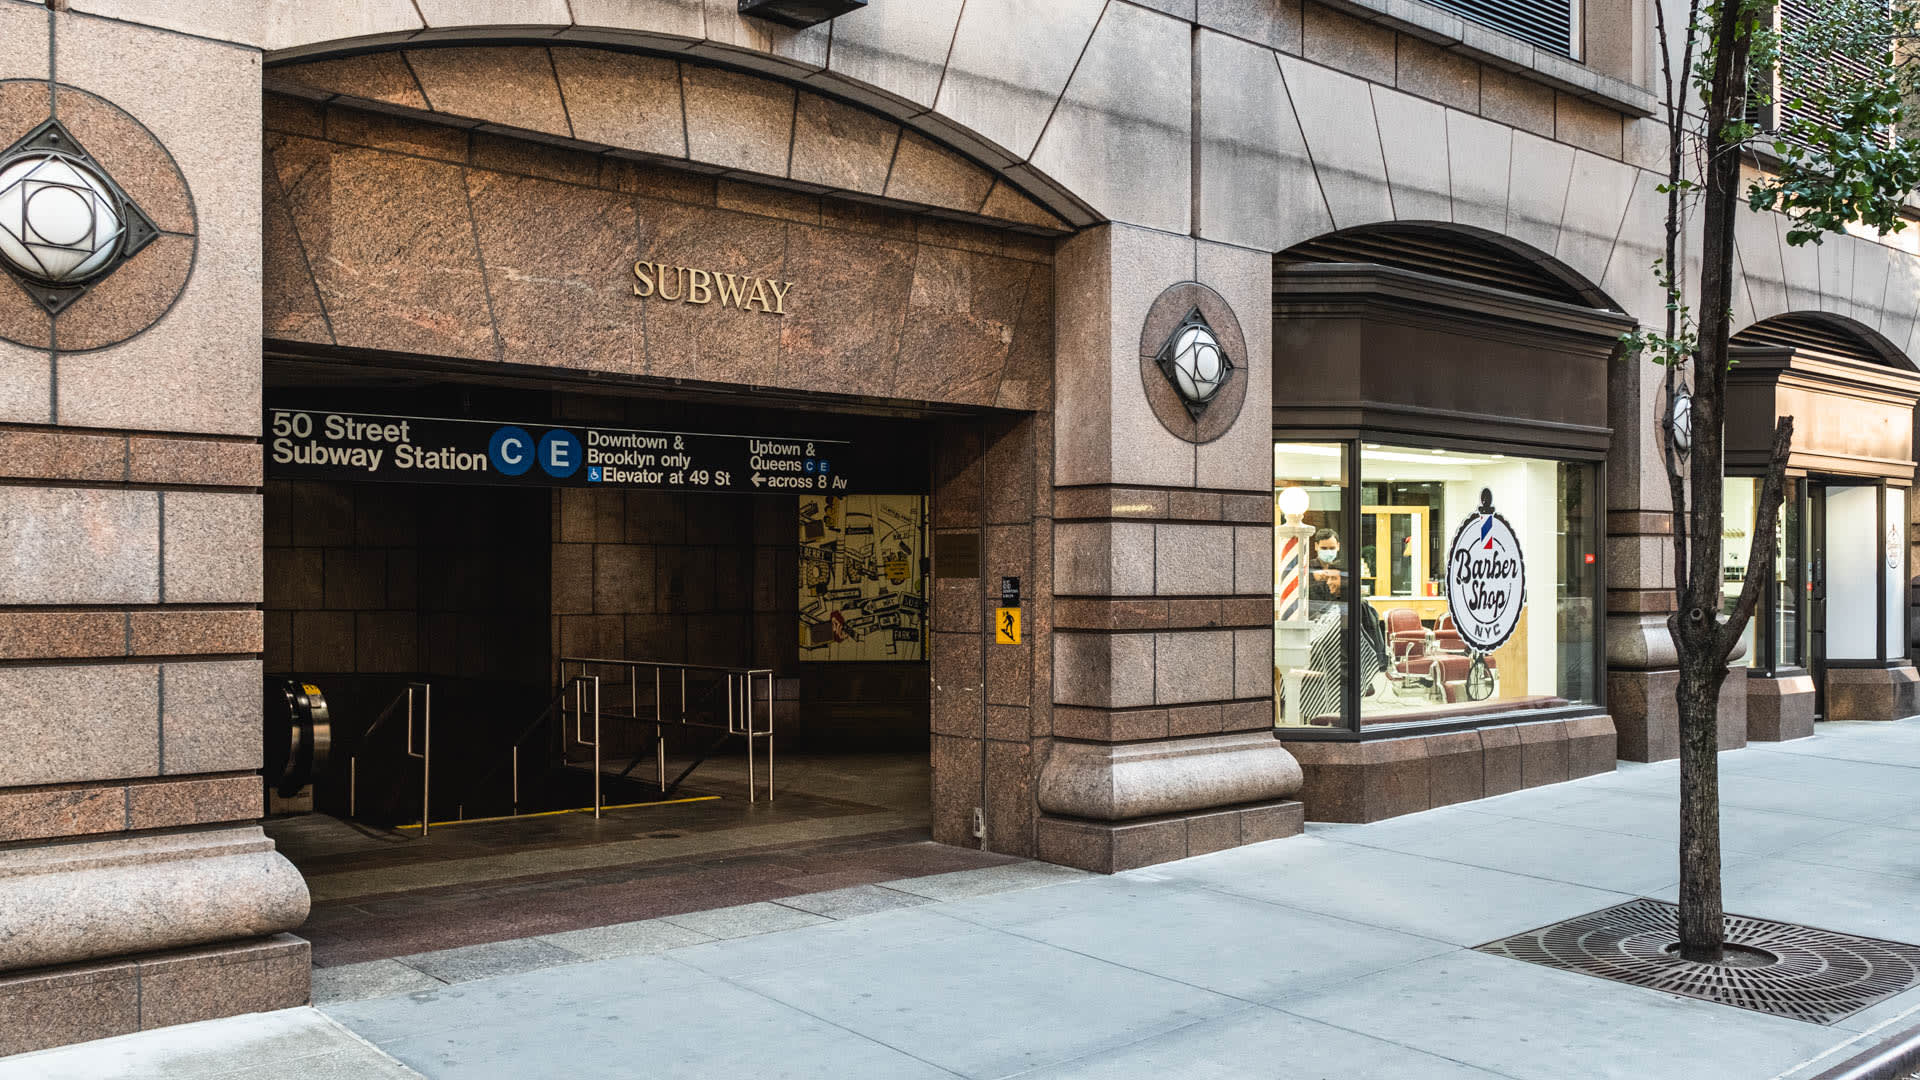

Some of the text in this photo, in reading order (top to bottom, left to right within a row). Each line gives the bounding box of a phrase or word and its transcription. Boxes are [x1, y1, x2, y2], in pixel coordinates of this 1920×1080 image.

[633, 260, 793, 315] SUBWAY
[272, 411, 411, 443] 50 Street
[587, 430, 685, 450] Downtown &
[750, 439, 816, 457] Uptown &
[272, 438, 488, 472] Subway Station
[500, 438, 570, 467] C E
[587, 448, 691, 470] Brooklyn only
[750, 455, 827, 472] Queens C E
[602, 466, 731, 486] Elevator at 49 St
[767, 474, 848, 489] across 8 Av
[1455, 548, 1519, 585] Barber
[1469, 580, 1506, 618] Shop
[1474, 624, 1501, 638] NYC
